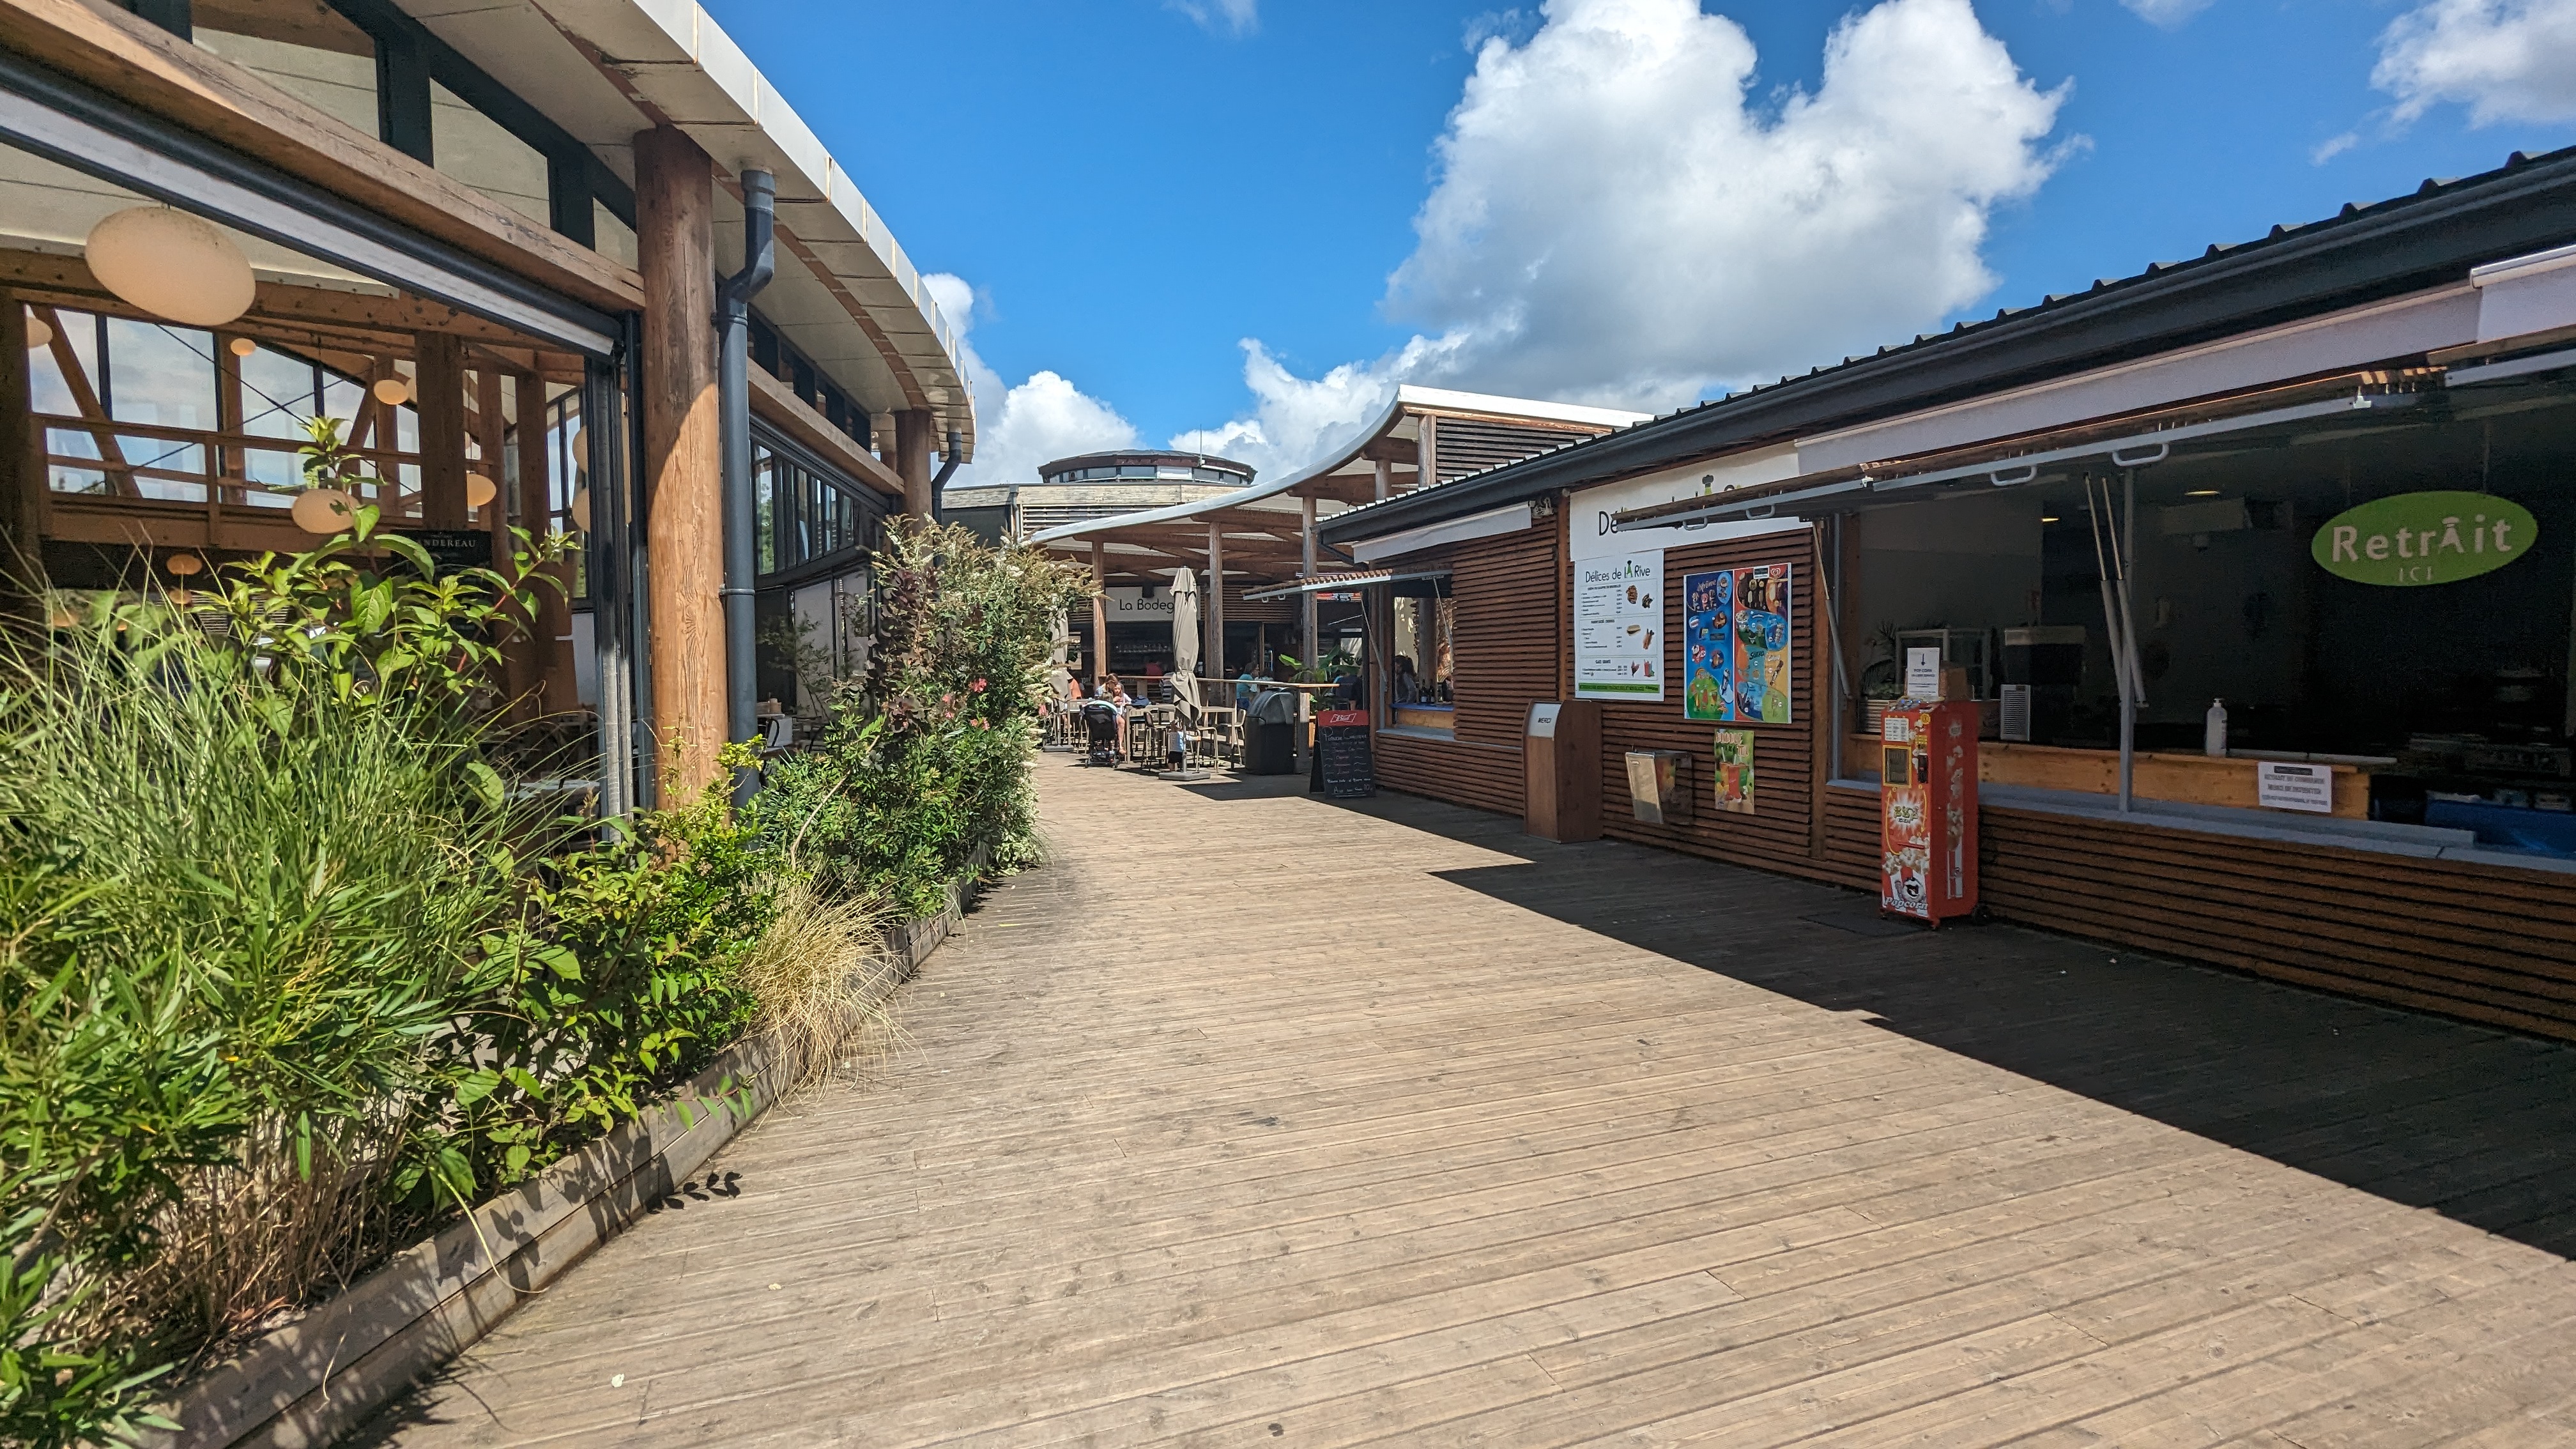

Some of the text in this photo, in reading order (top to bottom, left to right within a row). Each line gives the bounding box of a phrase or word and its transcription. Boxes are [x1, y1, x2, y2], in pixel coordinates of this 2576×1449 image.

[1586, 571, 1609, 583] Délices
[1612, 567, 1622, 579] de
[1634, 565, 1651, 578] Rive
[1119, 598, 1174, 614] La Bodeg
[1884, 896, 1929, 910] Popcorn
